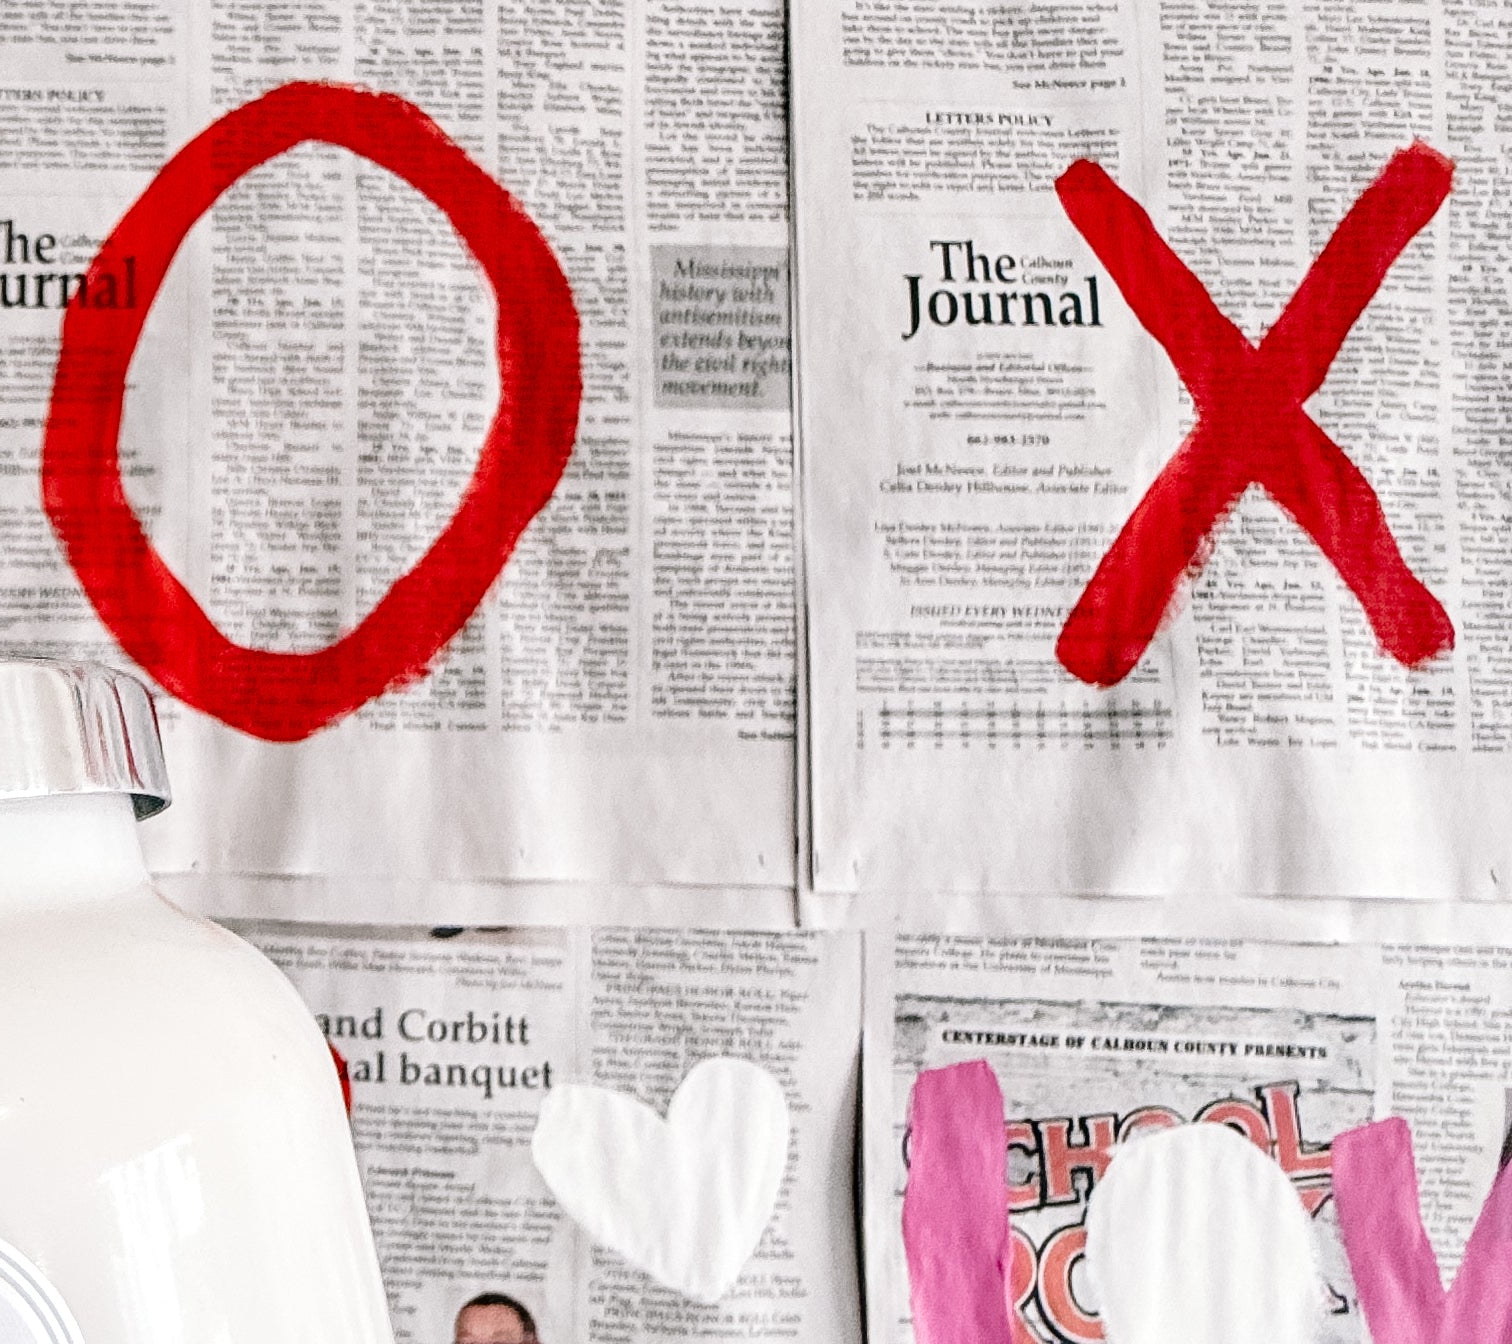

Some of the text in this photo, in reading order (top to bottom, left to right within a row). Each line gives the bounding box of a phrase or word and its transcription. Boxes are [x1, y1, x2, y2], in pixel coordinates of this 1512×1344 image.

[929, 239, 1018, 285] The
[901, 273, 1106, 342] Journal
[43, 79, 581, 742] O
[1055, 138, 1455, 686] X
[397, 1007, 531, 1046] Corbitt
[941, 1029, 1329, 1060] CENTERSTAGE OF CALHOUN COUNTY PRESENTS
[398, 1051, 554, 1101] banquet
